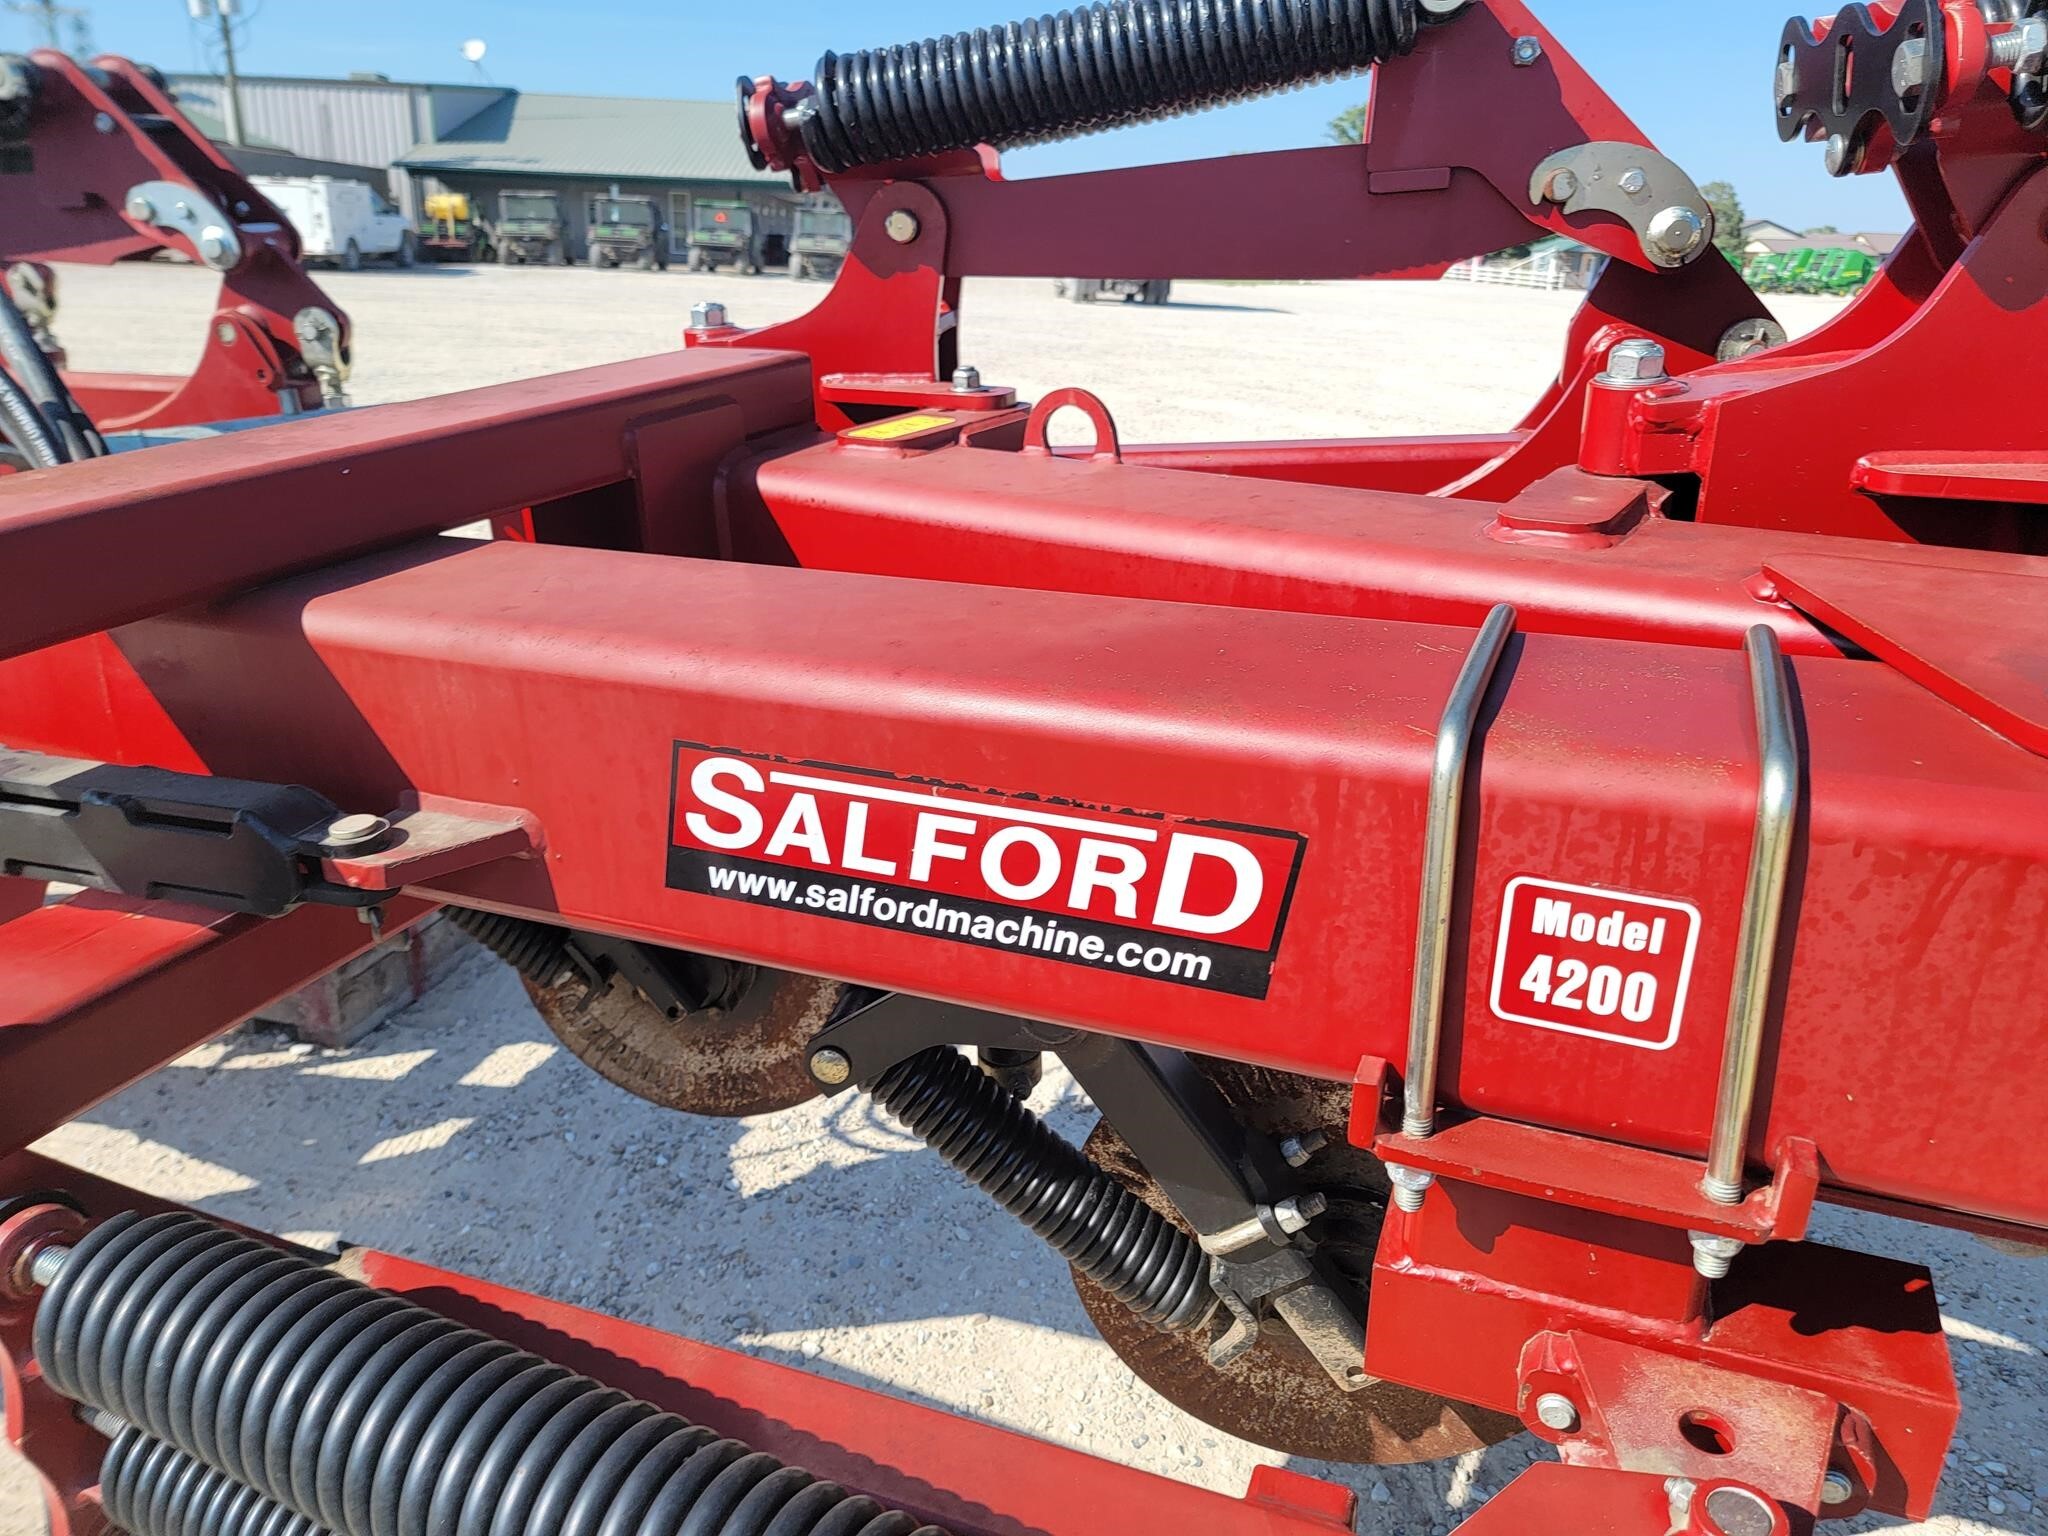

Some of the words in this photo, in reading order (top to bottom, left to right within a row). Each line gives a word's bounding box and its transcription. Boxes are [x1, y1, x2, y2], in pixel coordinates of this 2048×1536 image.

[685, 756, 1264, 934] SALFORD
[708, 865, 1212, 981] www.salfordmachine.com
[1531, 897, 1666, 955] Model
[1519, 954, 1658, 1023] 4200
